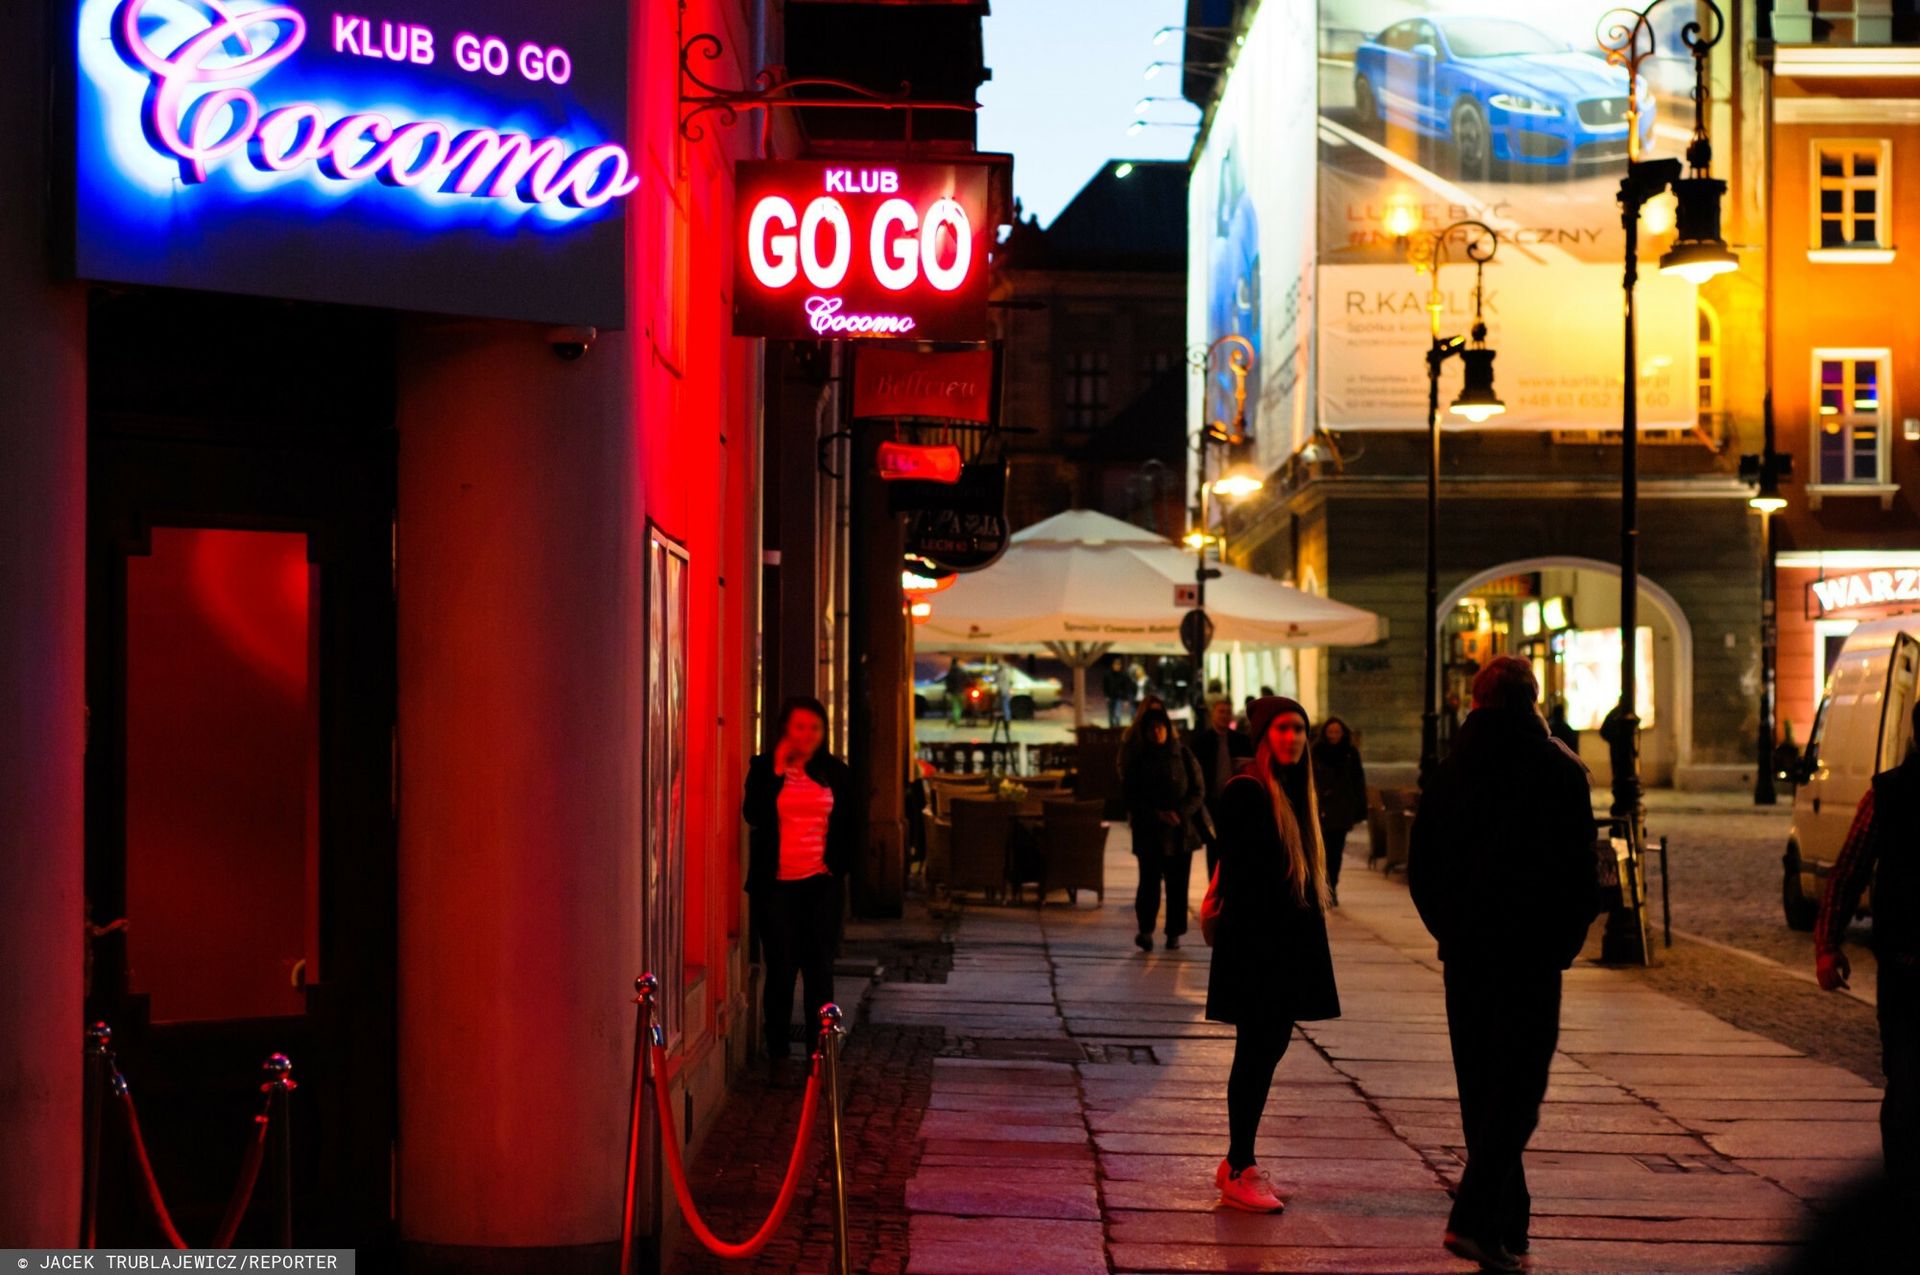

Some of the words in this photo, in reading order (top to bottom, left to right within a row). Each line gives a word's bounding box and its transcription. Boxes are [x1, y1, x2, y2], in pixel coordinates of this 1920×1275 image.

[333, 15, 436, 65] KLUB
[454, 34, 510, 76] GO
[517, 44, 572, 85] GO
[124, 0, 640, 209] Cocomo
[825, 169, 899, 193] KLUB
[748, 196, 850, 289] GO
[870, 198, 972, 291] GO
[805, 296, 915, 335] Cocomo
[1812, 568, 1920, 611] WARZ
